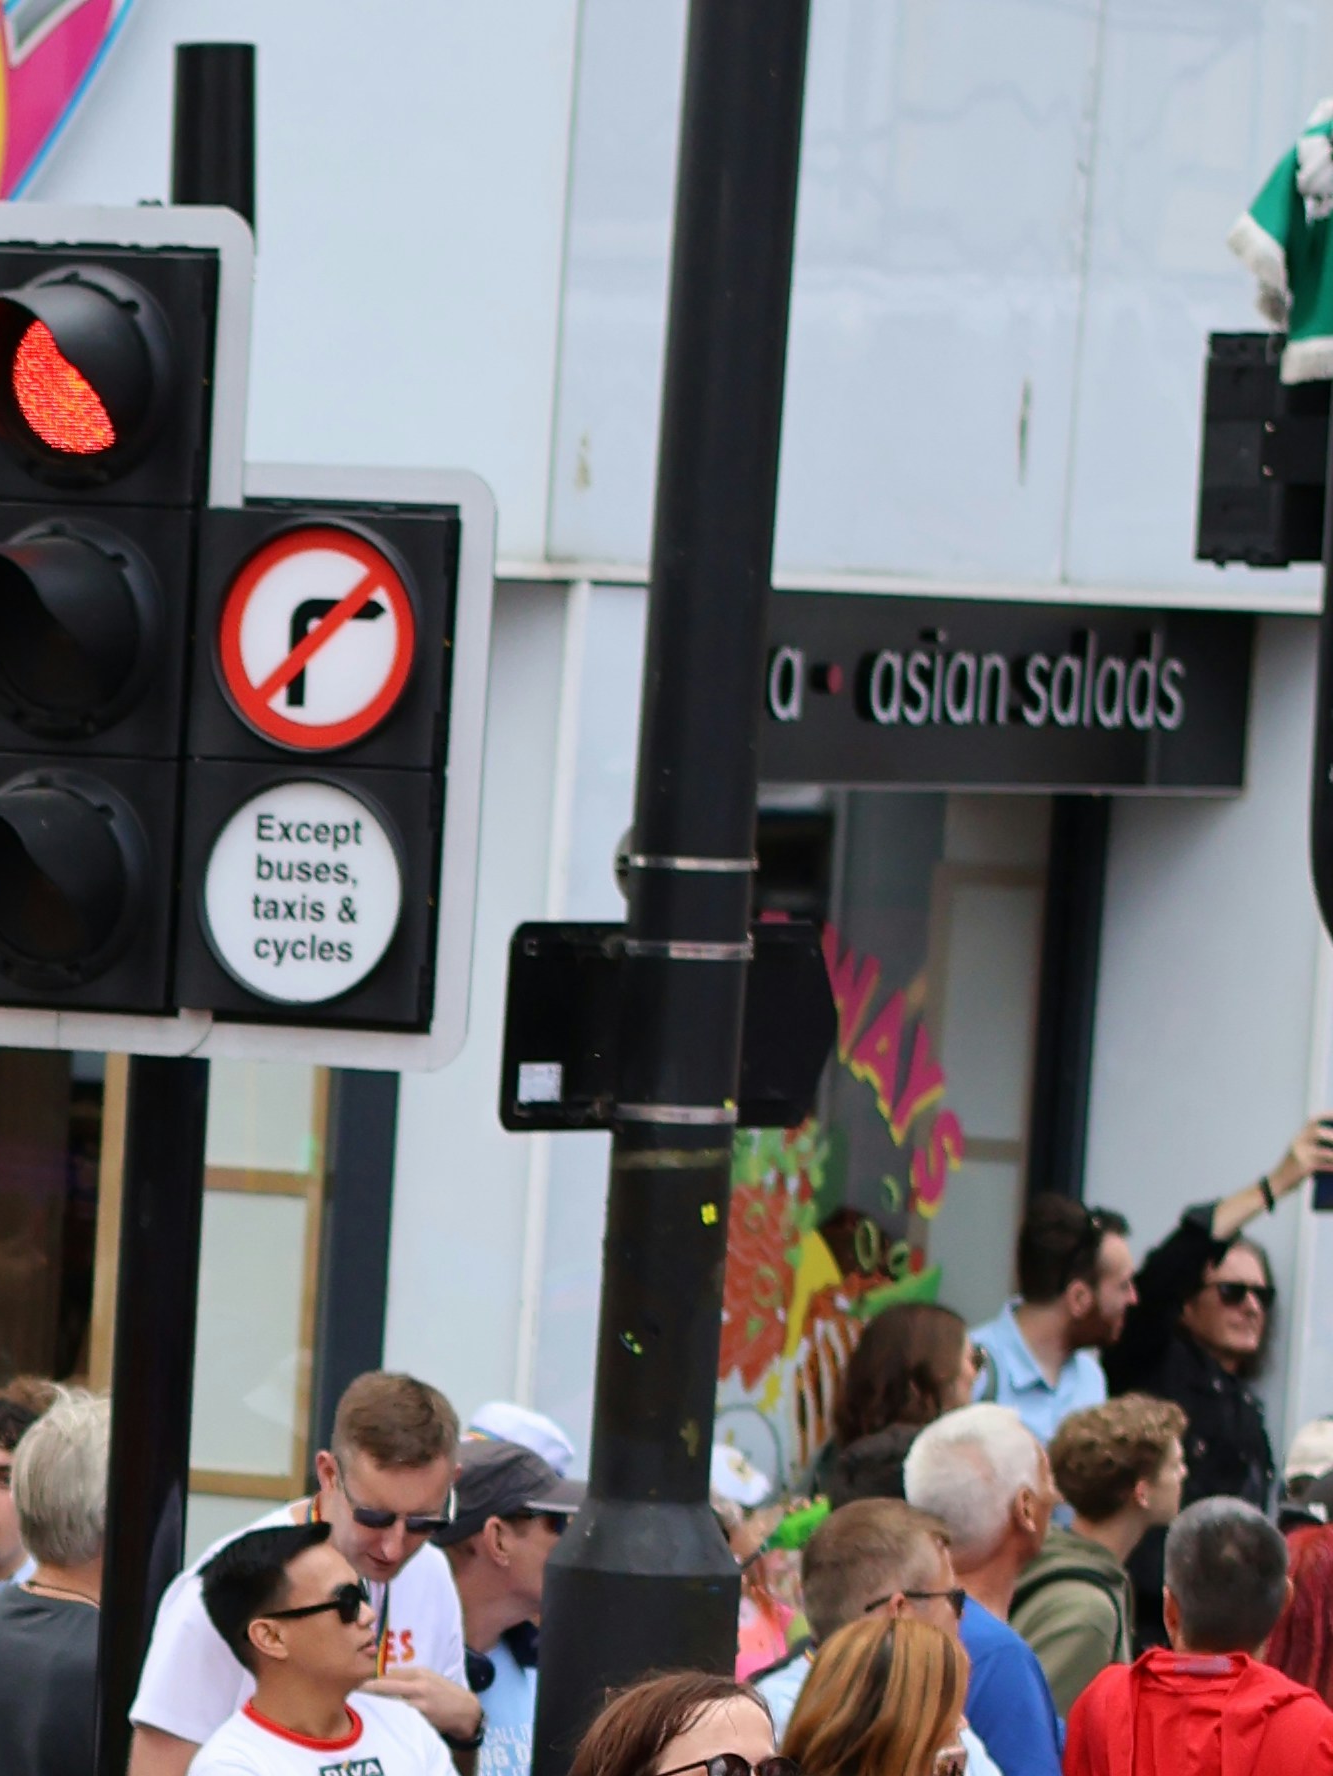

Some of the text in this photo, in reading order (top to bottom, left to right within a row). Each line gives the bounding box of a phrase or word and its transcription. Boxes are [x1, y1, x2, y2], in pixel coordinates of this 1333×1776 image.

[869, 629, 1009, 727] asian
[1021, 632, 1185, 731] salads
[255, 812, 364, 852] Except
[254, 852, 359, 890] buses,
[251, 893, 358, 925] taxis &
[252, 933, 354, 968] cycles
